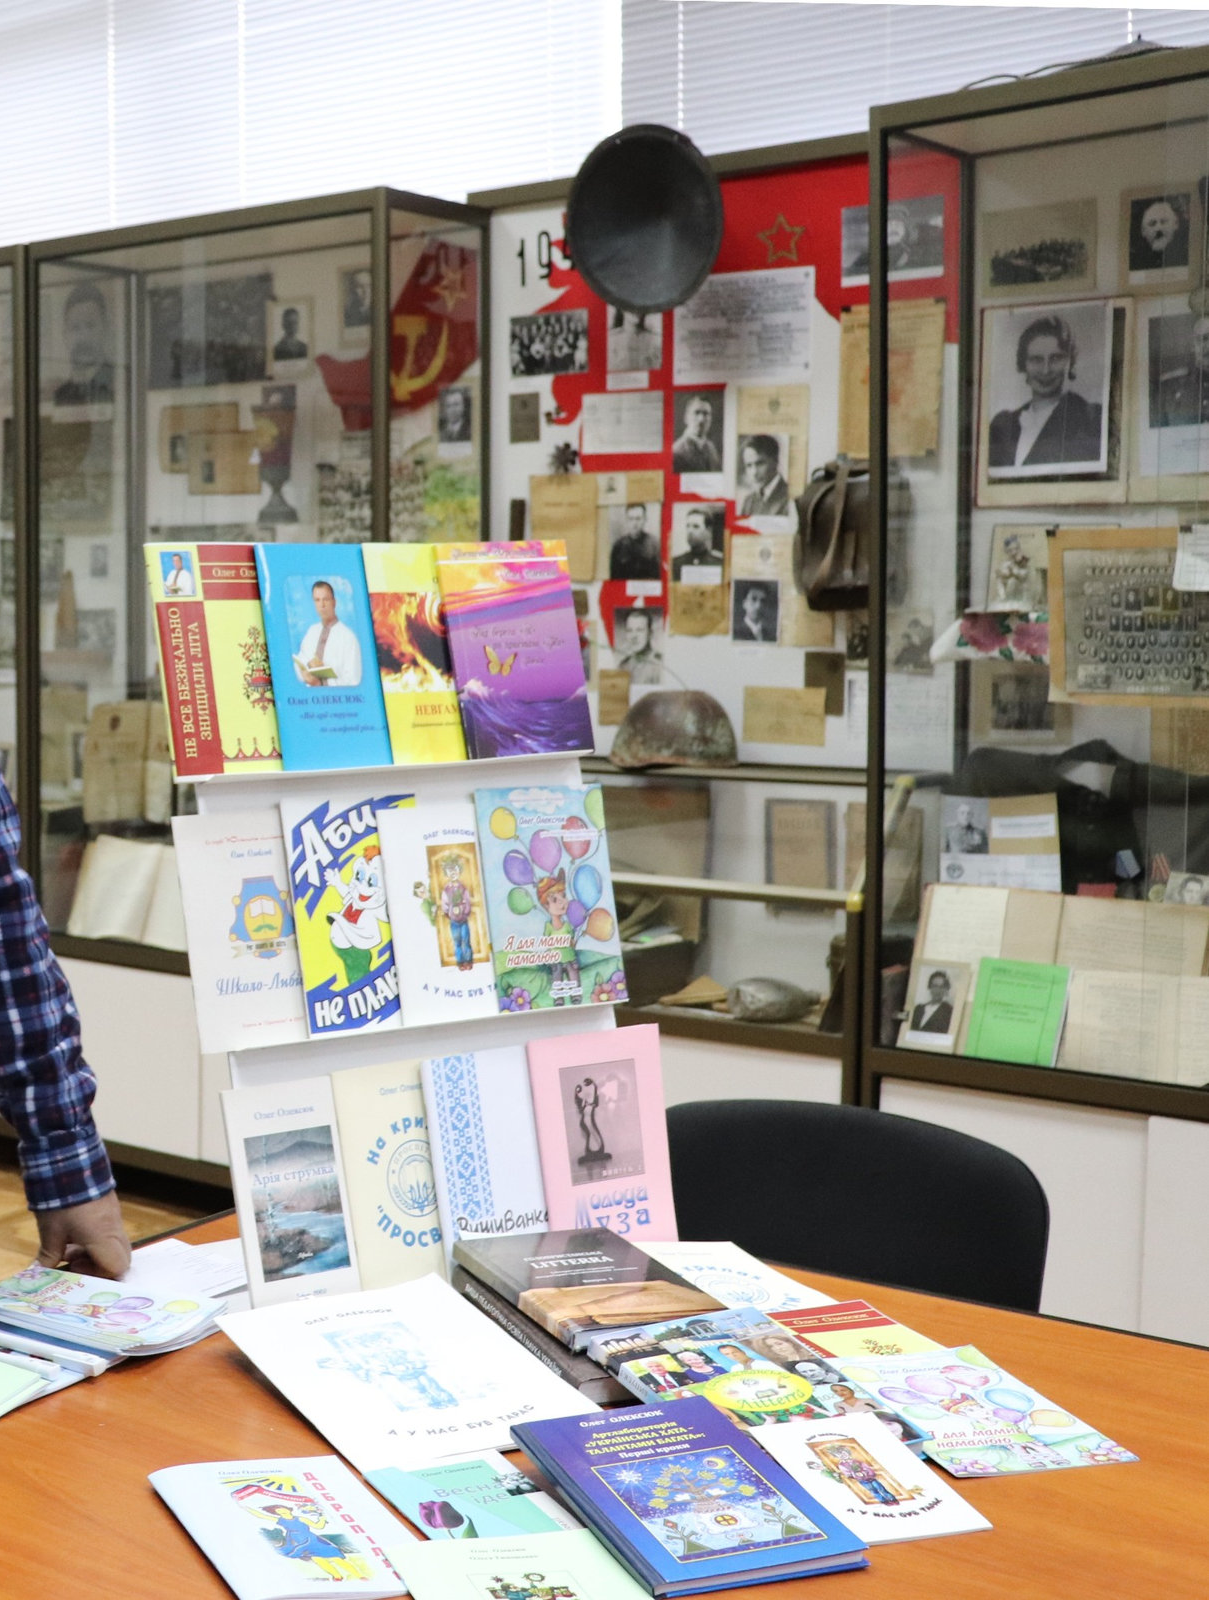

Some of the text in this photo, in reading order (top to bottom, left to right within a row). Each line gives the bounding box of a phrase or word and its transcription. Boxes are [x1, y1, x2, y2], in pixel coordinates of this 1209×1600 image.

[212, 566, 237, 578] Олег
[168, 606, 197, 758] НЕ ВСЕ БЕЗЖАЛЬНО
[188, 620, 213, 741] ЗНИЩИЛИ ЛІТА
[504, 934, 571, 950] Я для мами
[507, 952, 561, 967] намалюю
[444, 989, 464, 998] НАС
[253, 1165, 335, 1188] Арія струмка
[530, 1254, 614, 1270] LITTERRA
[305, 1316, 330, 1326] ОЛЕГ
[426, 1425, 459, 1436] НАС
[497, 1404, 535, 1423] ТАРАС
[579, 1409, 664, 1428] Олег ОЛЕКСЮК
[585, 1430, 660, 1448] «УКРАЇНСЬКА
[661, 1427, 688, 1438] ХАТА
[592, 1421, 678, 1439] Артлабораторія
[942, 1429, 967, 1440] для
[586, 1439, 656, 1456] ТАЛАНТАМИ
[618, 1443, 690, 1459] Перші кроки
[937, 1436, 1012, 1450] намалюю
[434, 1481, 504, 1498] Весна
[474, 1492, 508, 1505] іде
